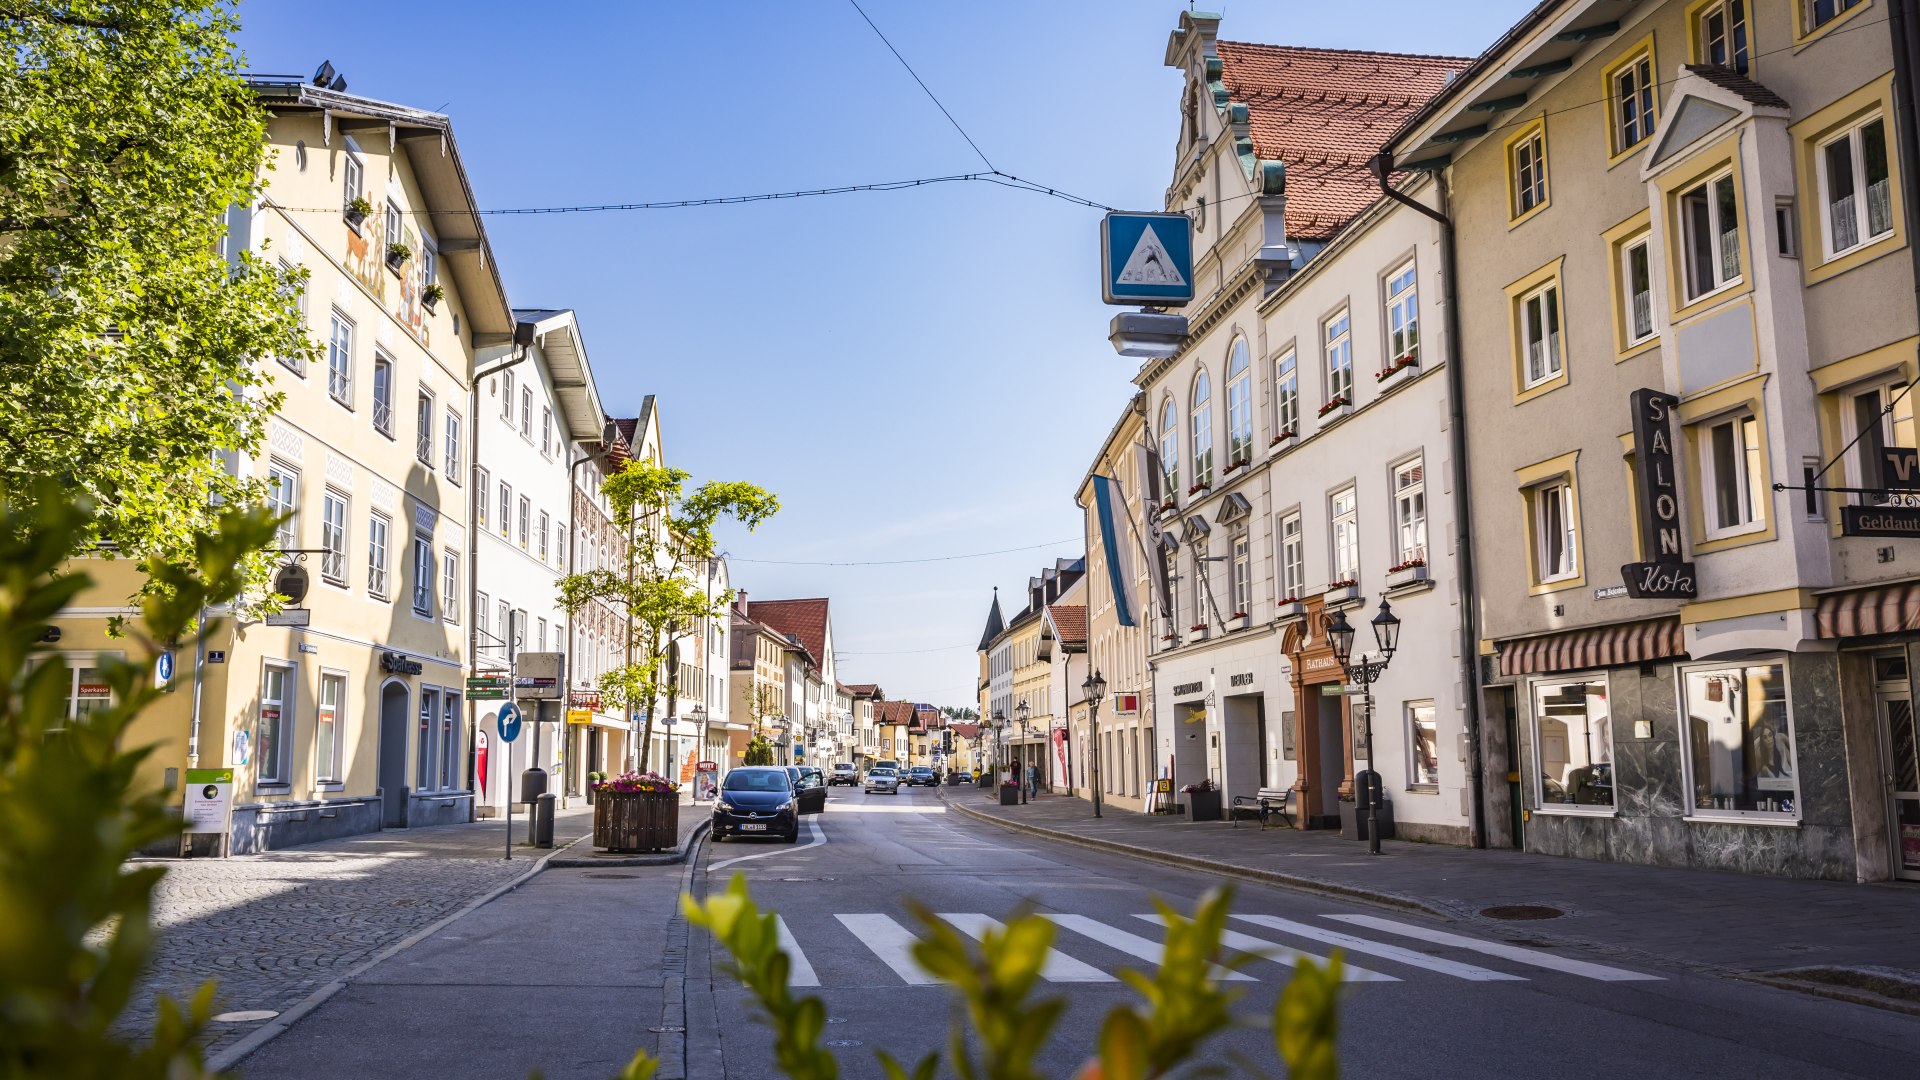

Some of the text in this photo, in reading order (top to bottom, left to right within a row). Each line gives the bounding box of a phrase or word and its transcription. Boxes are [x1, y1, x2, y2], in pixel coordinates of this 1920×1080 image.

[1648, 395, 1680, 555] SALON
[1858, 514, 1920, 530] Geldaut
[382, 652, 422, 675] Sparkasse
[1896, 735, 1914, 758] Salo
